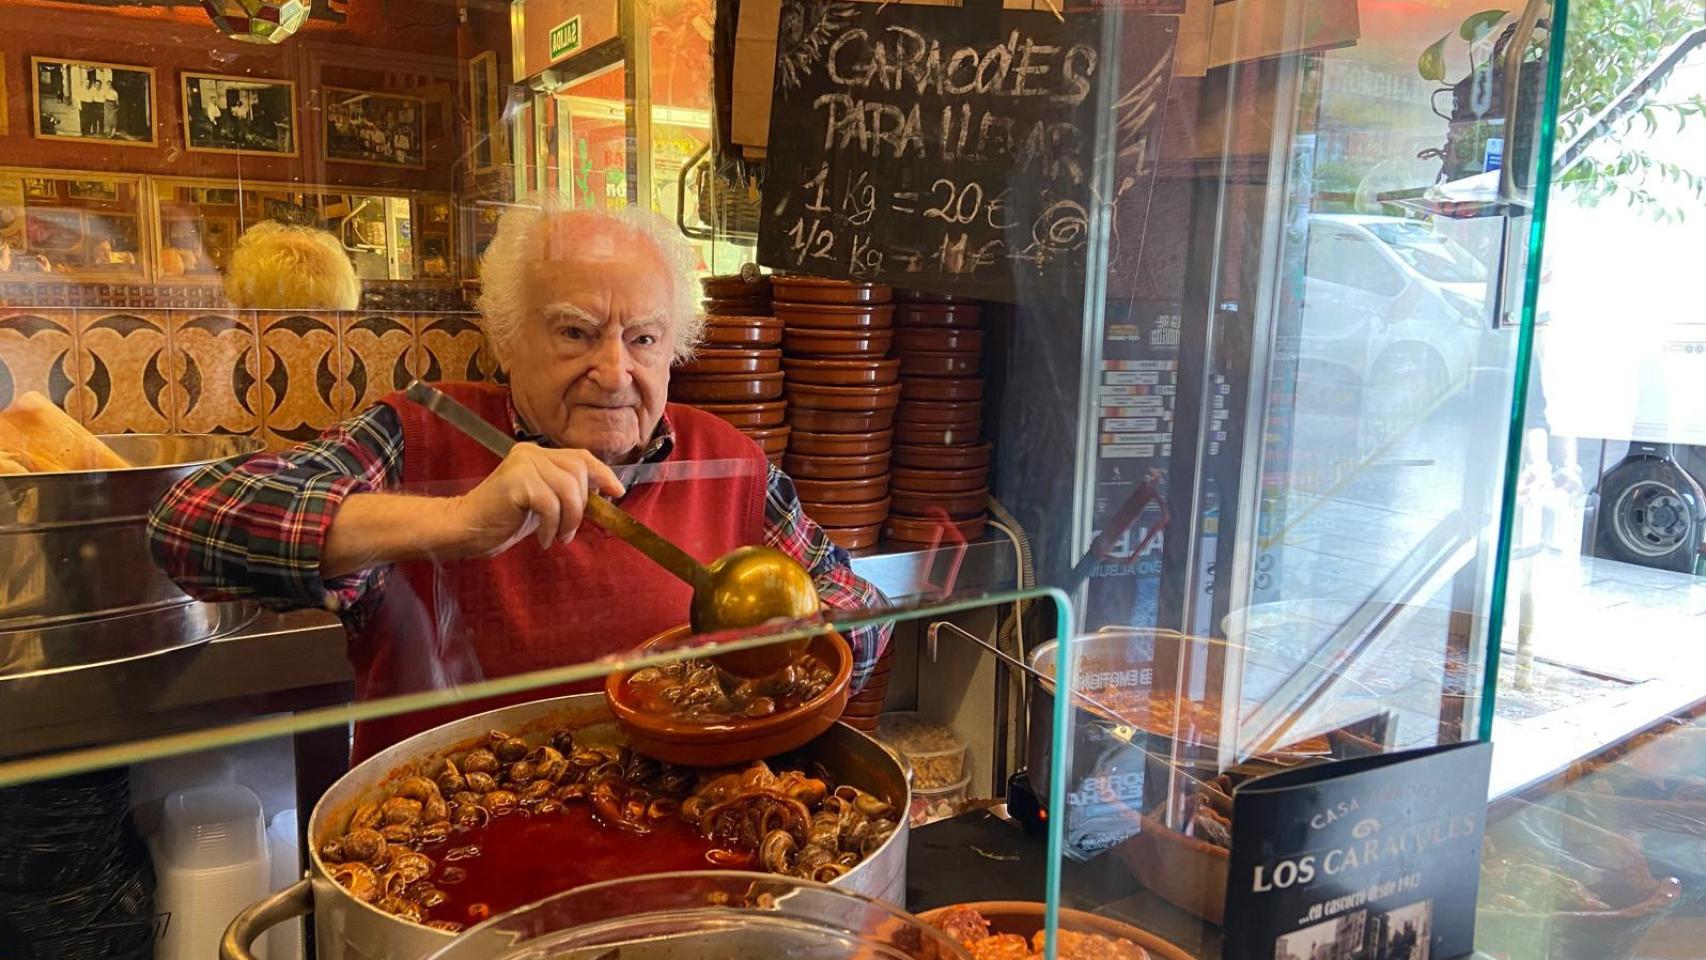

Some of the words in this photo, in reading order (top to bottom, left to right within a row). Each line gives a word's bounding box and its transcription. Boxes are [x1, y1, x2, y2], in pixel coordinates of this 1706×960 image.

[813, 93, 926, 158] PARA
[803, 160, 831, 212] 1
[784, 217, 838, 265] 1/2
[1310, 799, 1360, 830] CASA
[1252, 855, 1316, 893] LOS
